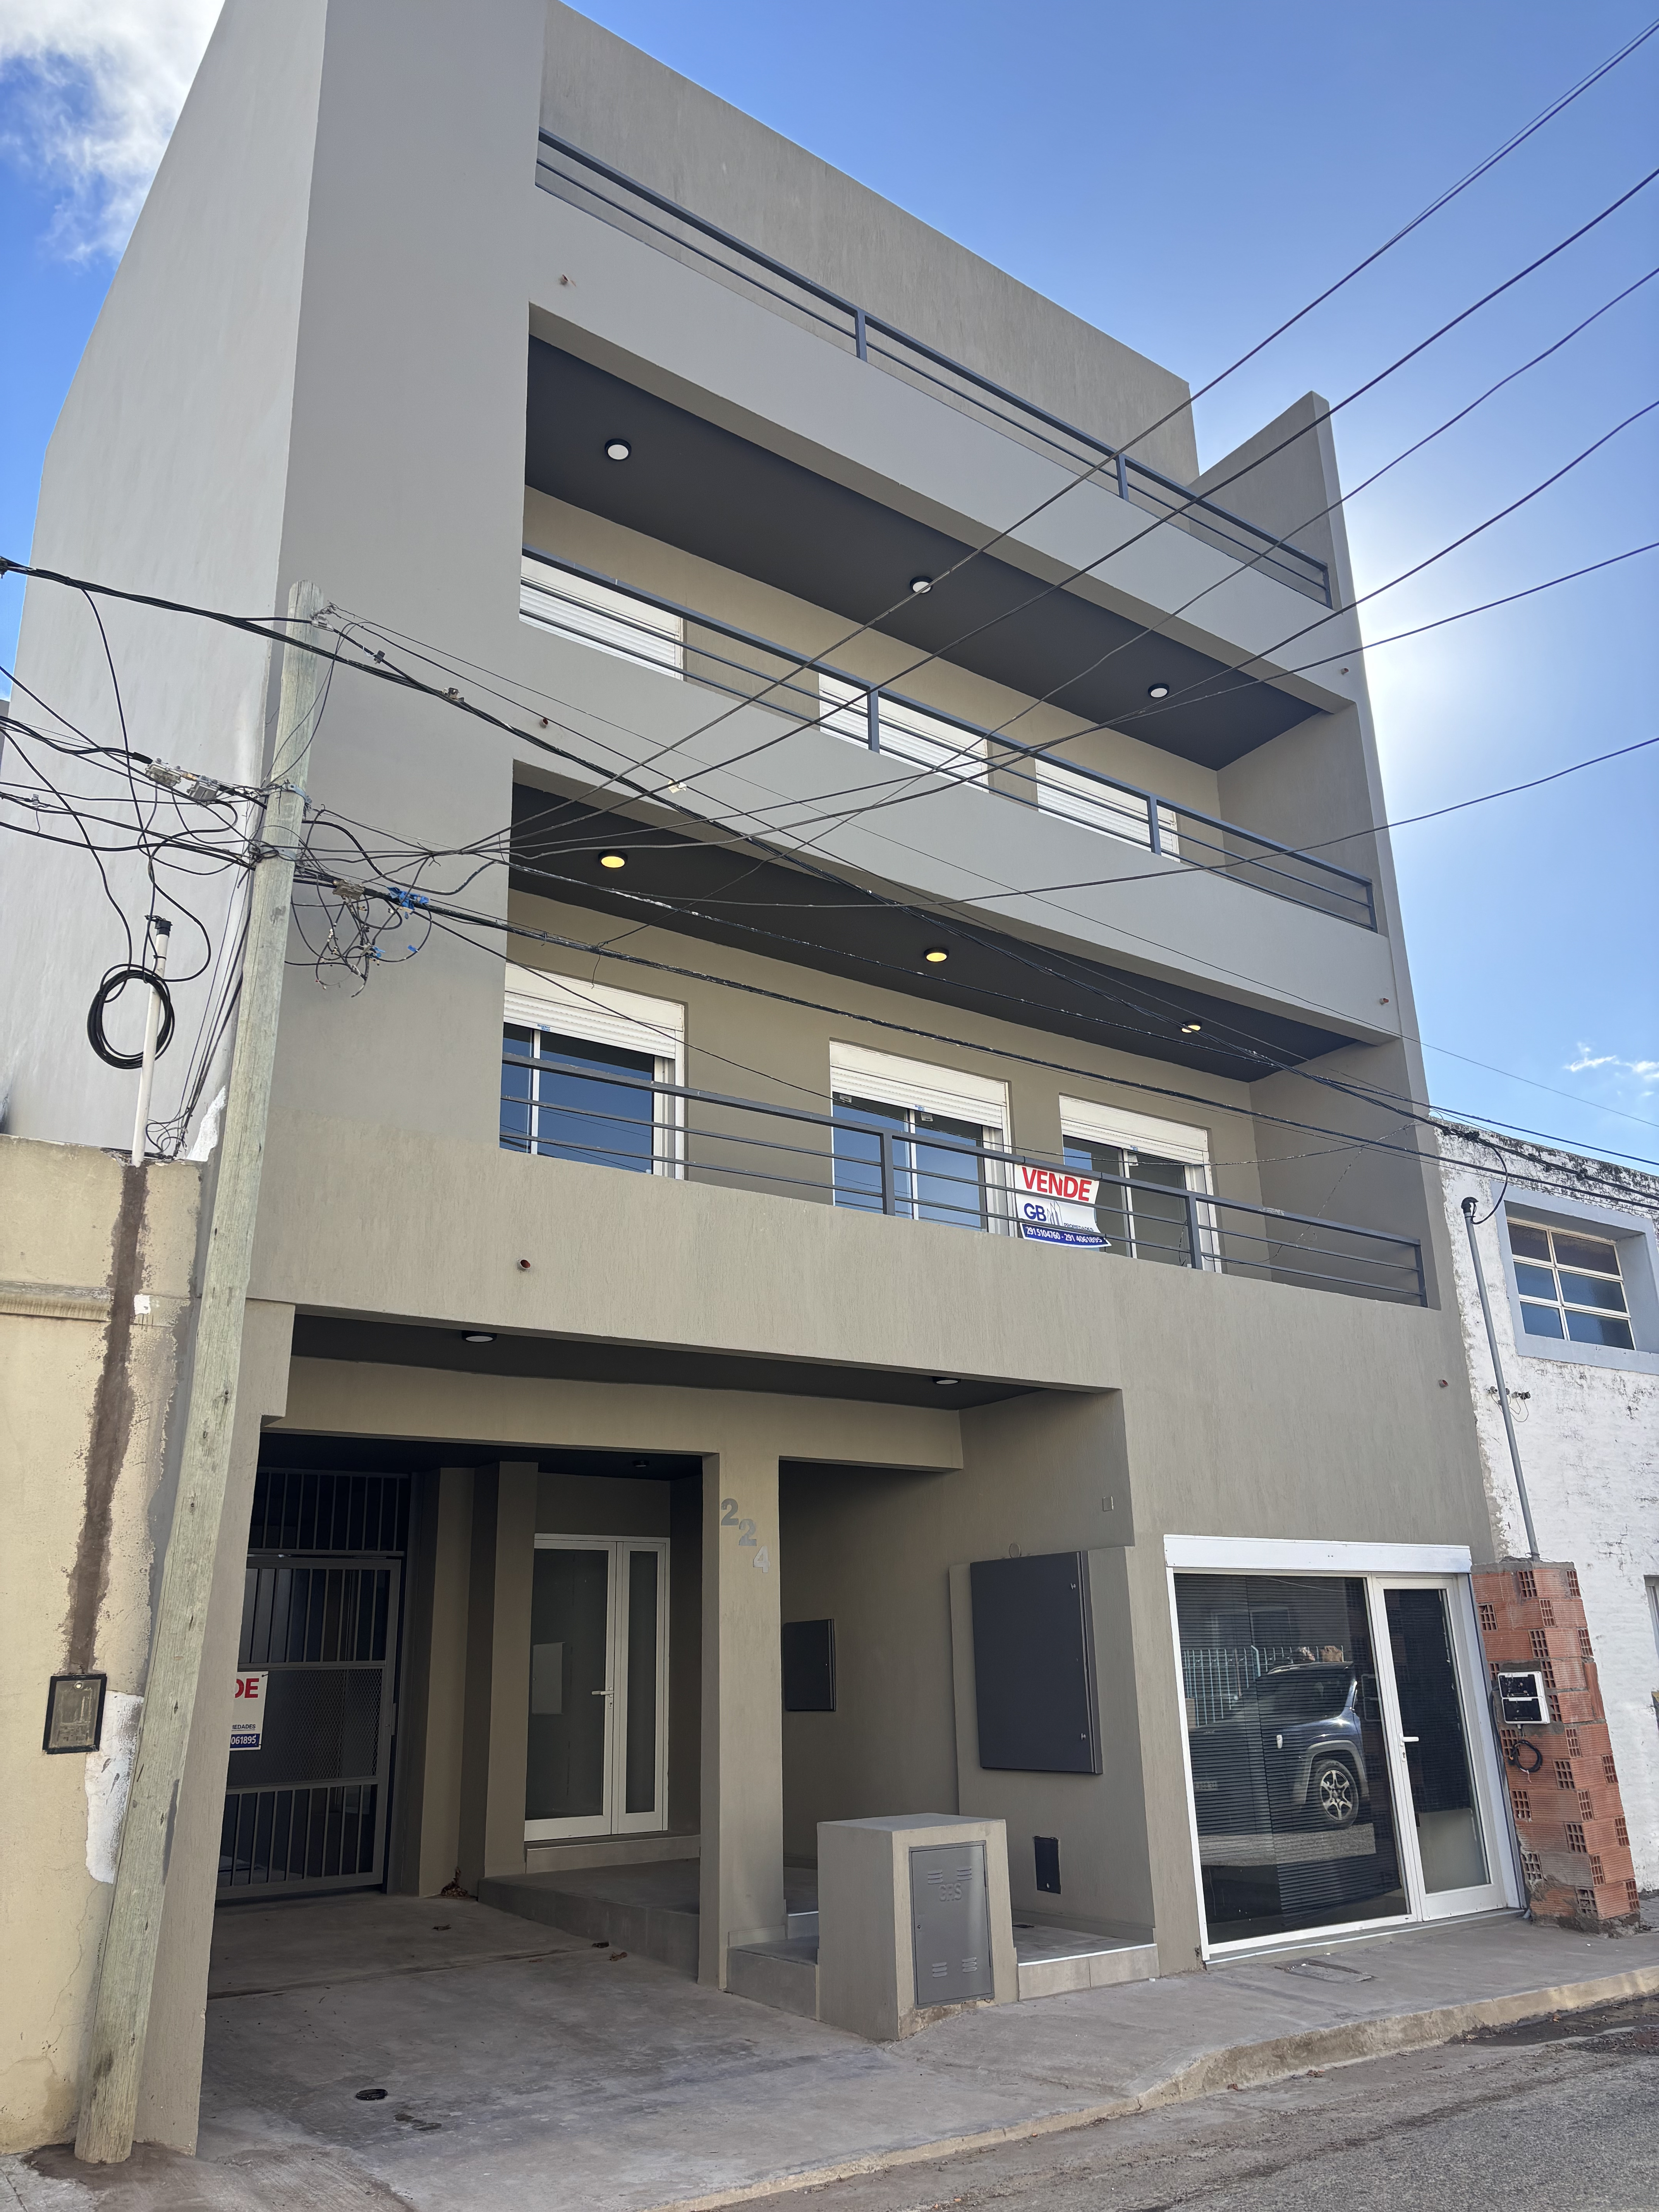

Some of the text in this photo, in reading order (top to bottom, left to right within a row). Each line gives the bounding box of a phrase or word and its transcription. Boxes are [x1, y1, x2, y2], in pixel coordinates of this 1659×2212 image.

[1022, 1167, 1091, 1201] VENDE
[1024, 1203, 1046, 1222] GB
[1025, 1226, 1037, 1236] 291
[1036, 1228, 1061, 1240] 5104760
[1064, 1233, 1075, 1242] 291
[721, 1498, 771, 1573] 224
